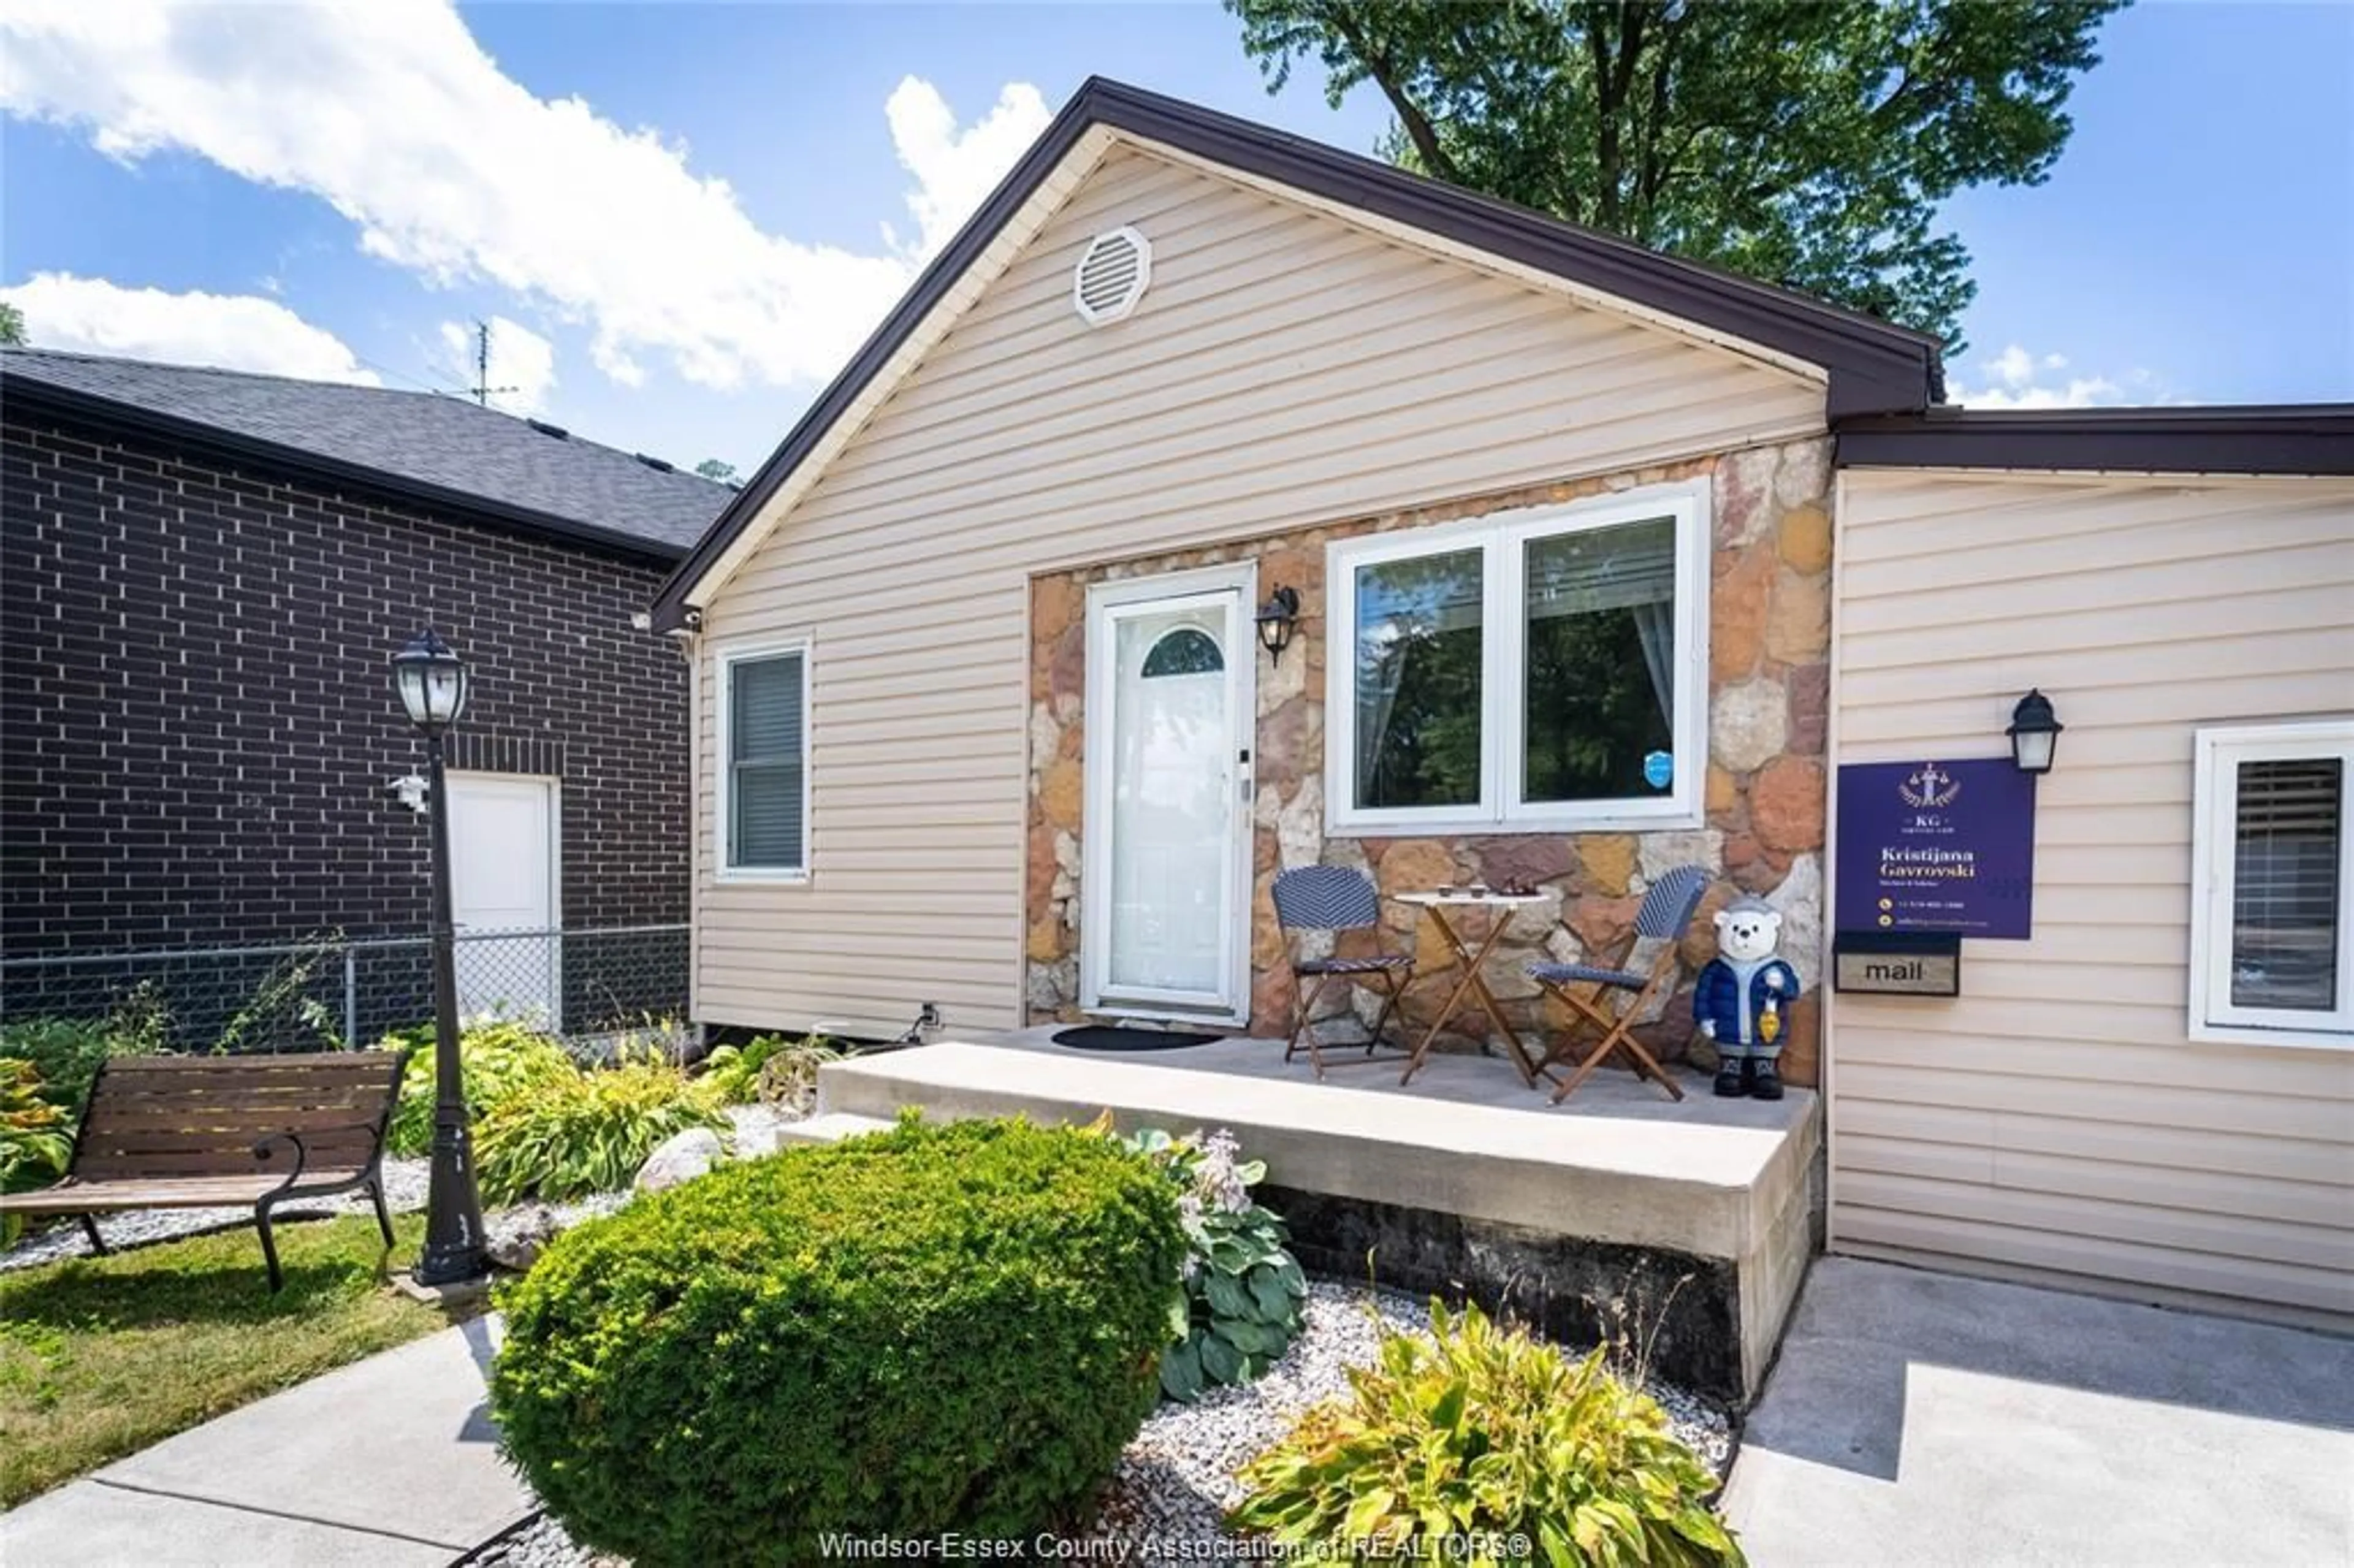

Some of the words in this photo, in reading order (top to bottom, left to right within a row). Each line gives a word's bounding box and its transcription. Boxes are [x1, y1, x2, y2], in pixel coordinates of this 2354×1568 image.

[1916, 815, 1941, 827] KG
[1881, 847, 1974, 865] Kristijana
[1880, 864, 1975, 878] Gavrovski
[1866, 962, 1923, 981] mail
